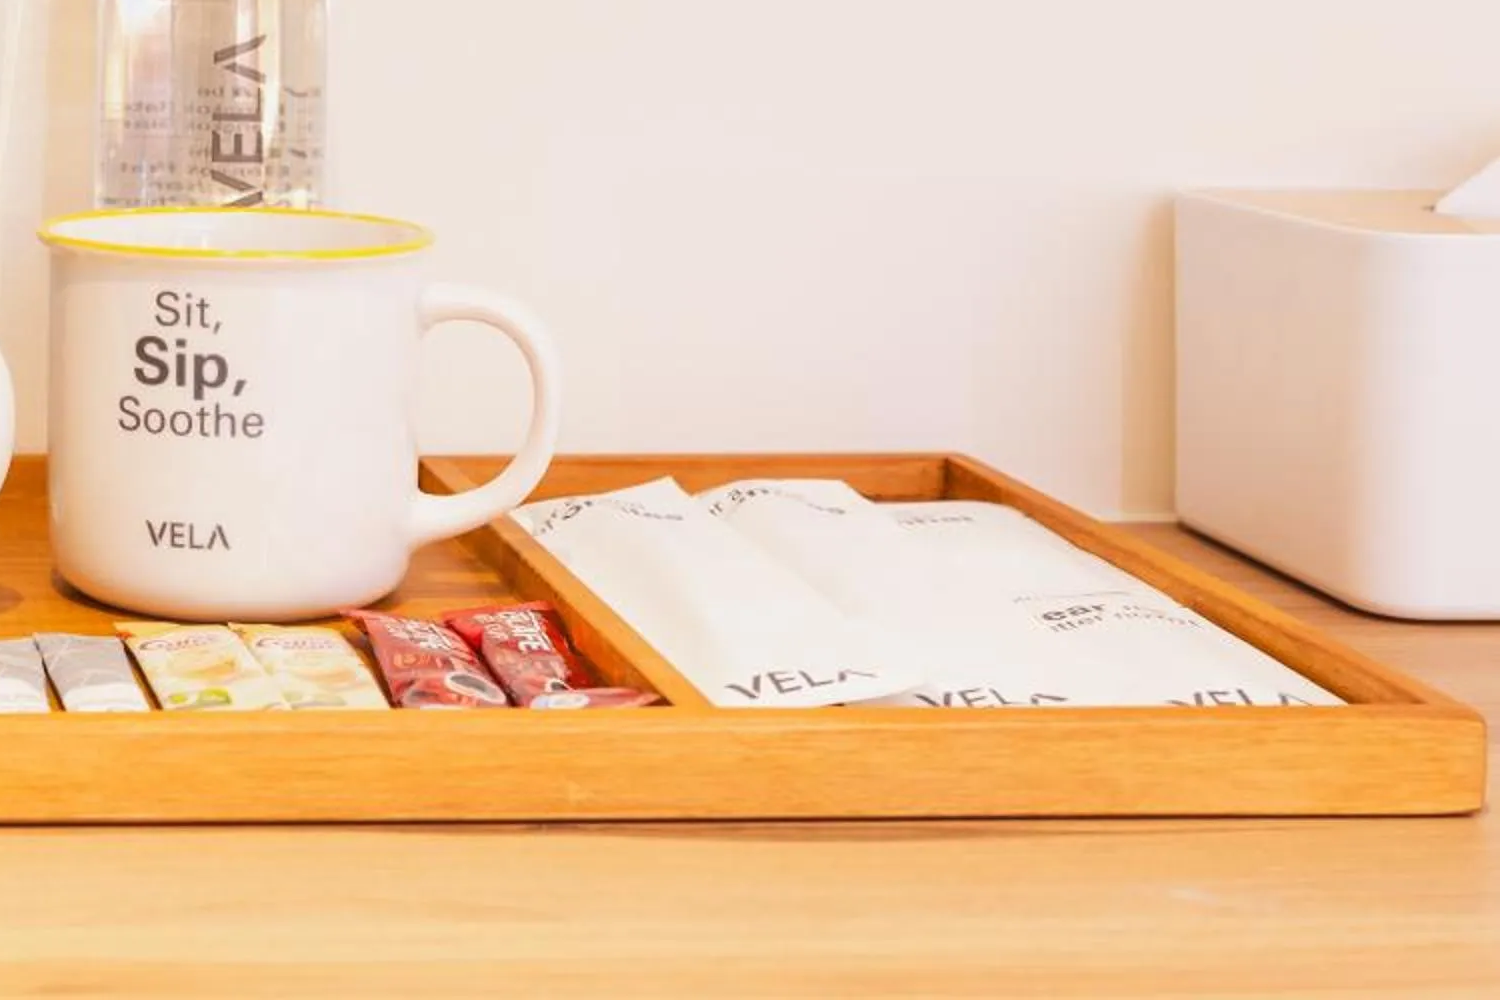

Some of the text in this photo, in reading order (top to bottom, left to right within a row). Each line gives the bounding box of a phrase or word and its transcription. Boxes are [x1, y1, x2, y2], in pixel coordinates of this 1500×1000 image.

[211, 34, 267, 207] VELA
[154, 290, 222, 334] Sit,
[133, 335, 247, 401] Sip,
[117, 395, 265, 439] Soothe
[145, 519, 231, 551] VELA
[724, 669, 880, 699] VELA
